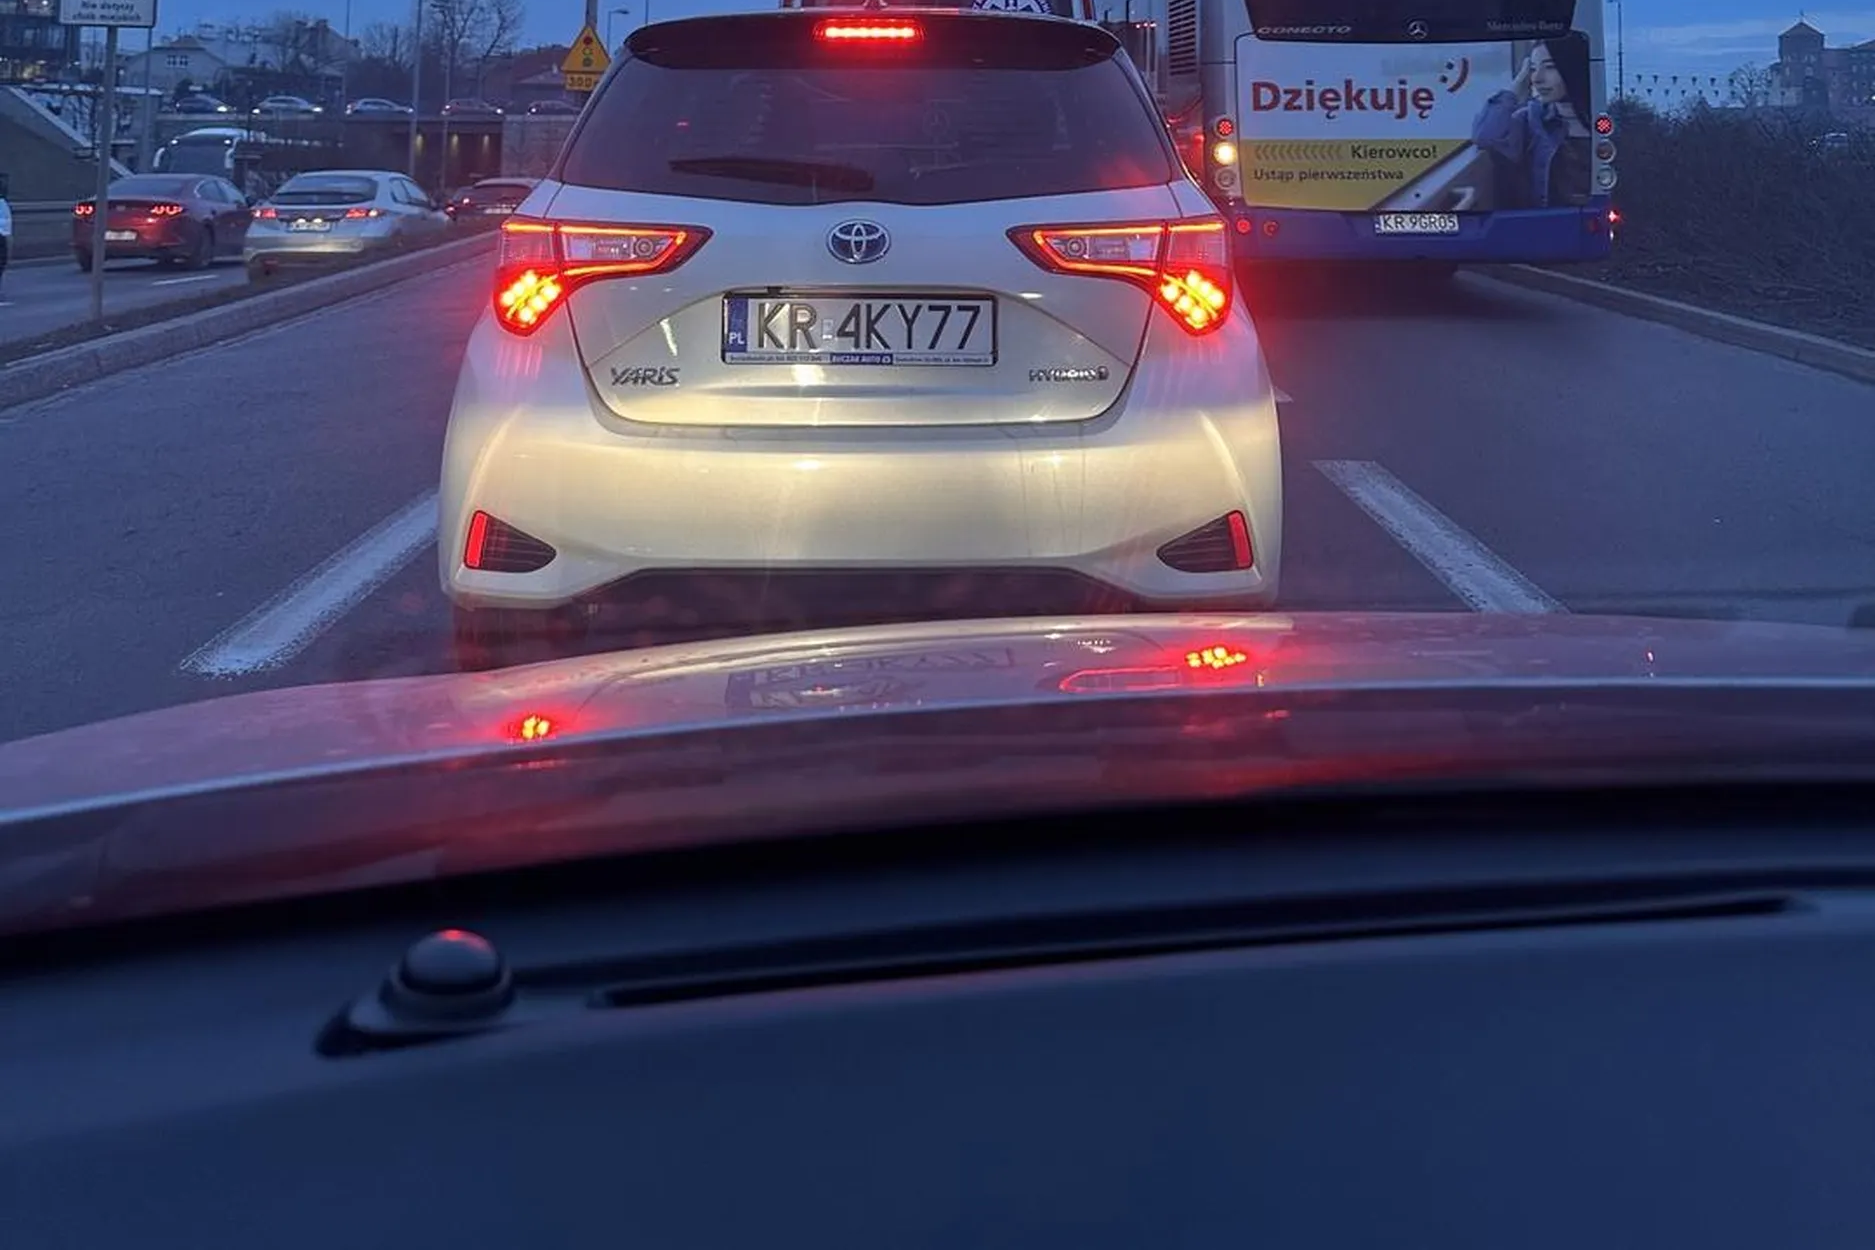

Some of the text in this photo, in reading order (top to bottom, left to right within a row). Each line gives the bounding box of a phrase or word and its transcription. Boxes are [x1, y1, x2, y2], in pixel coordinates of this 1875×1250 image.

[1252, 78, 1435, 120] Dziękuję
[1351, 144, 1438, 159] Kierowco!
[1253, 167, 1404, 181] Ustąp pierwszeństwa
[1384, 214, 1405, 230] KR
[758, 303, 981, 350] KR 4KY77
[729, 332, 745, 345] PL
[610, 367, 681, 386] YARIS
